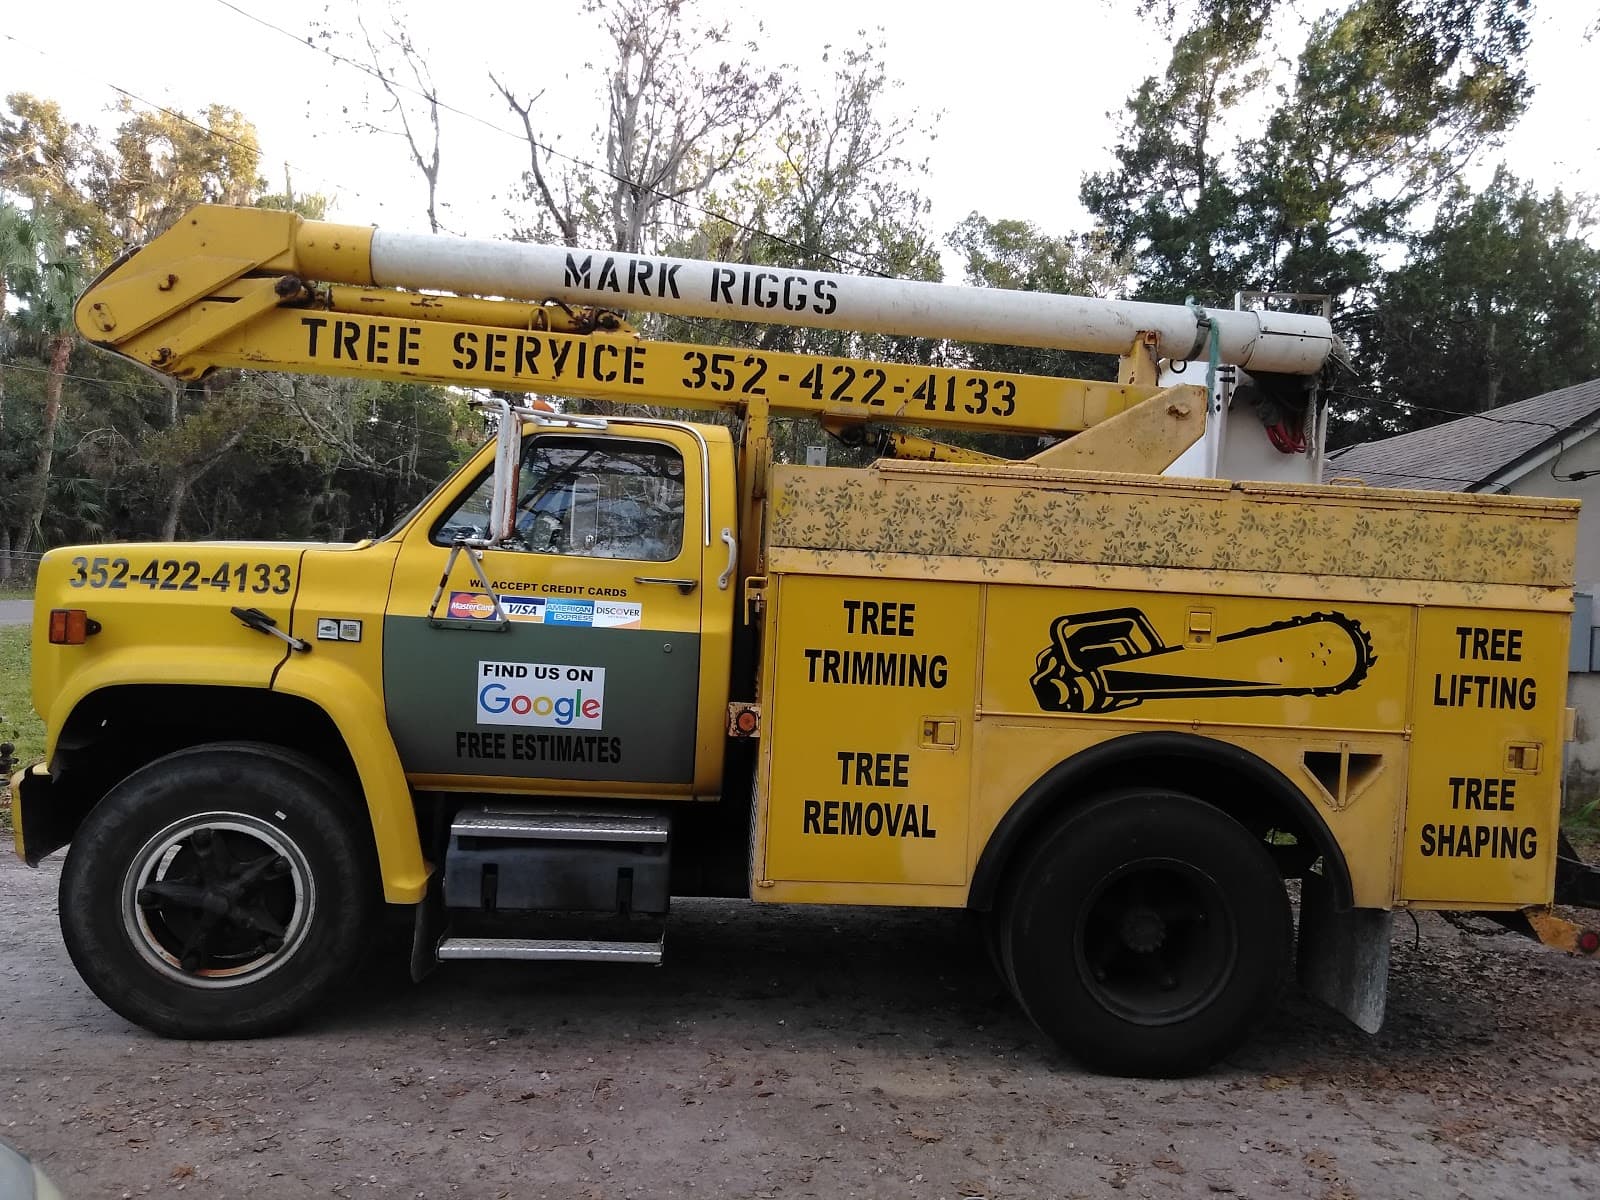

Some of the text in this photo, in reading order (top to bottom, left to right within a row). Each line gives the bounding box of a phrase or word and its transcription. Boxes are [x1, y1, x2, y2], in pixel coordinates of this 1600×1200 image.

[564, 253, 838, 315] MARK RIGGS
[301, 318, 1016, 417] TREE SERVICE 352-422-4133
[68, 556, 291, 594] 352-422-4133
[491, 581, 538, 592] ACCEPT
[541, 584, 584, 595] CREDIT
[588, 587, 627, 597] CARDS
[508, 604, 537, 615] VISA
[546, 604, 591, 614] AMERICAN
[555, 613, 593, 621] EXPRESS
[596, 606, 640, 616] DISCOVER
[843, 600, 915, 636] TREE
[1456, 626, 1523, 662] TREE
[483, 664, 593, 682] FIND US ON
[804, 648, 948, 689] TRIMMING
[479, 683, 600, 725] Google
[1433, 673, 1537, 710] LIFTING
[456, 731, 621, 764] FREE ESTIMATES
[837, 751, 910, 787] TREE
[1449, 777, 1516, 811] TREE
[803, 800, 937, 838] REMOVAL
[1420, 823, 1537, 860] SHAPING
